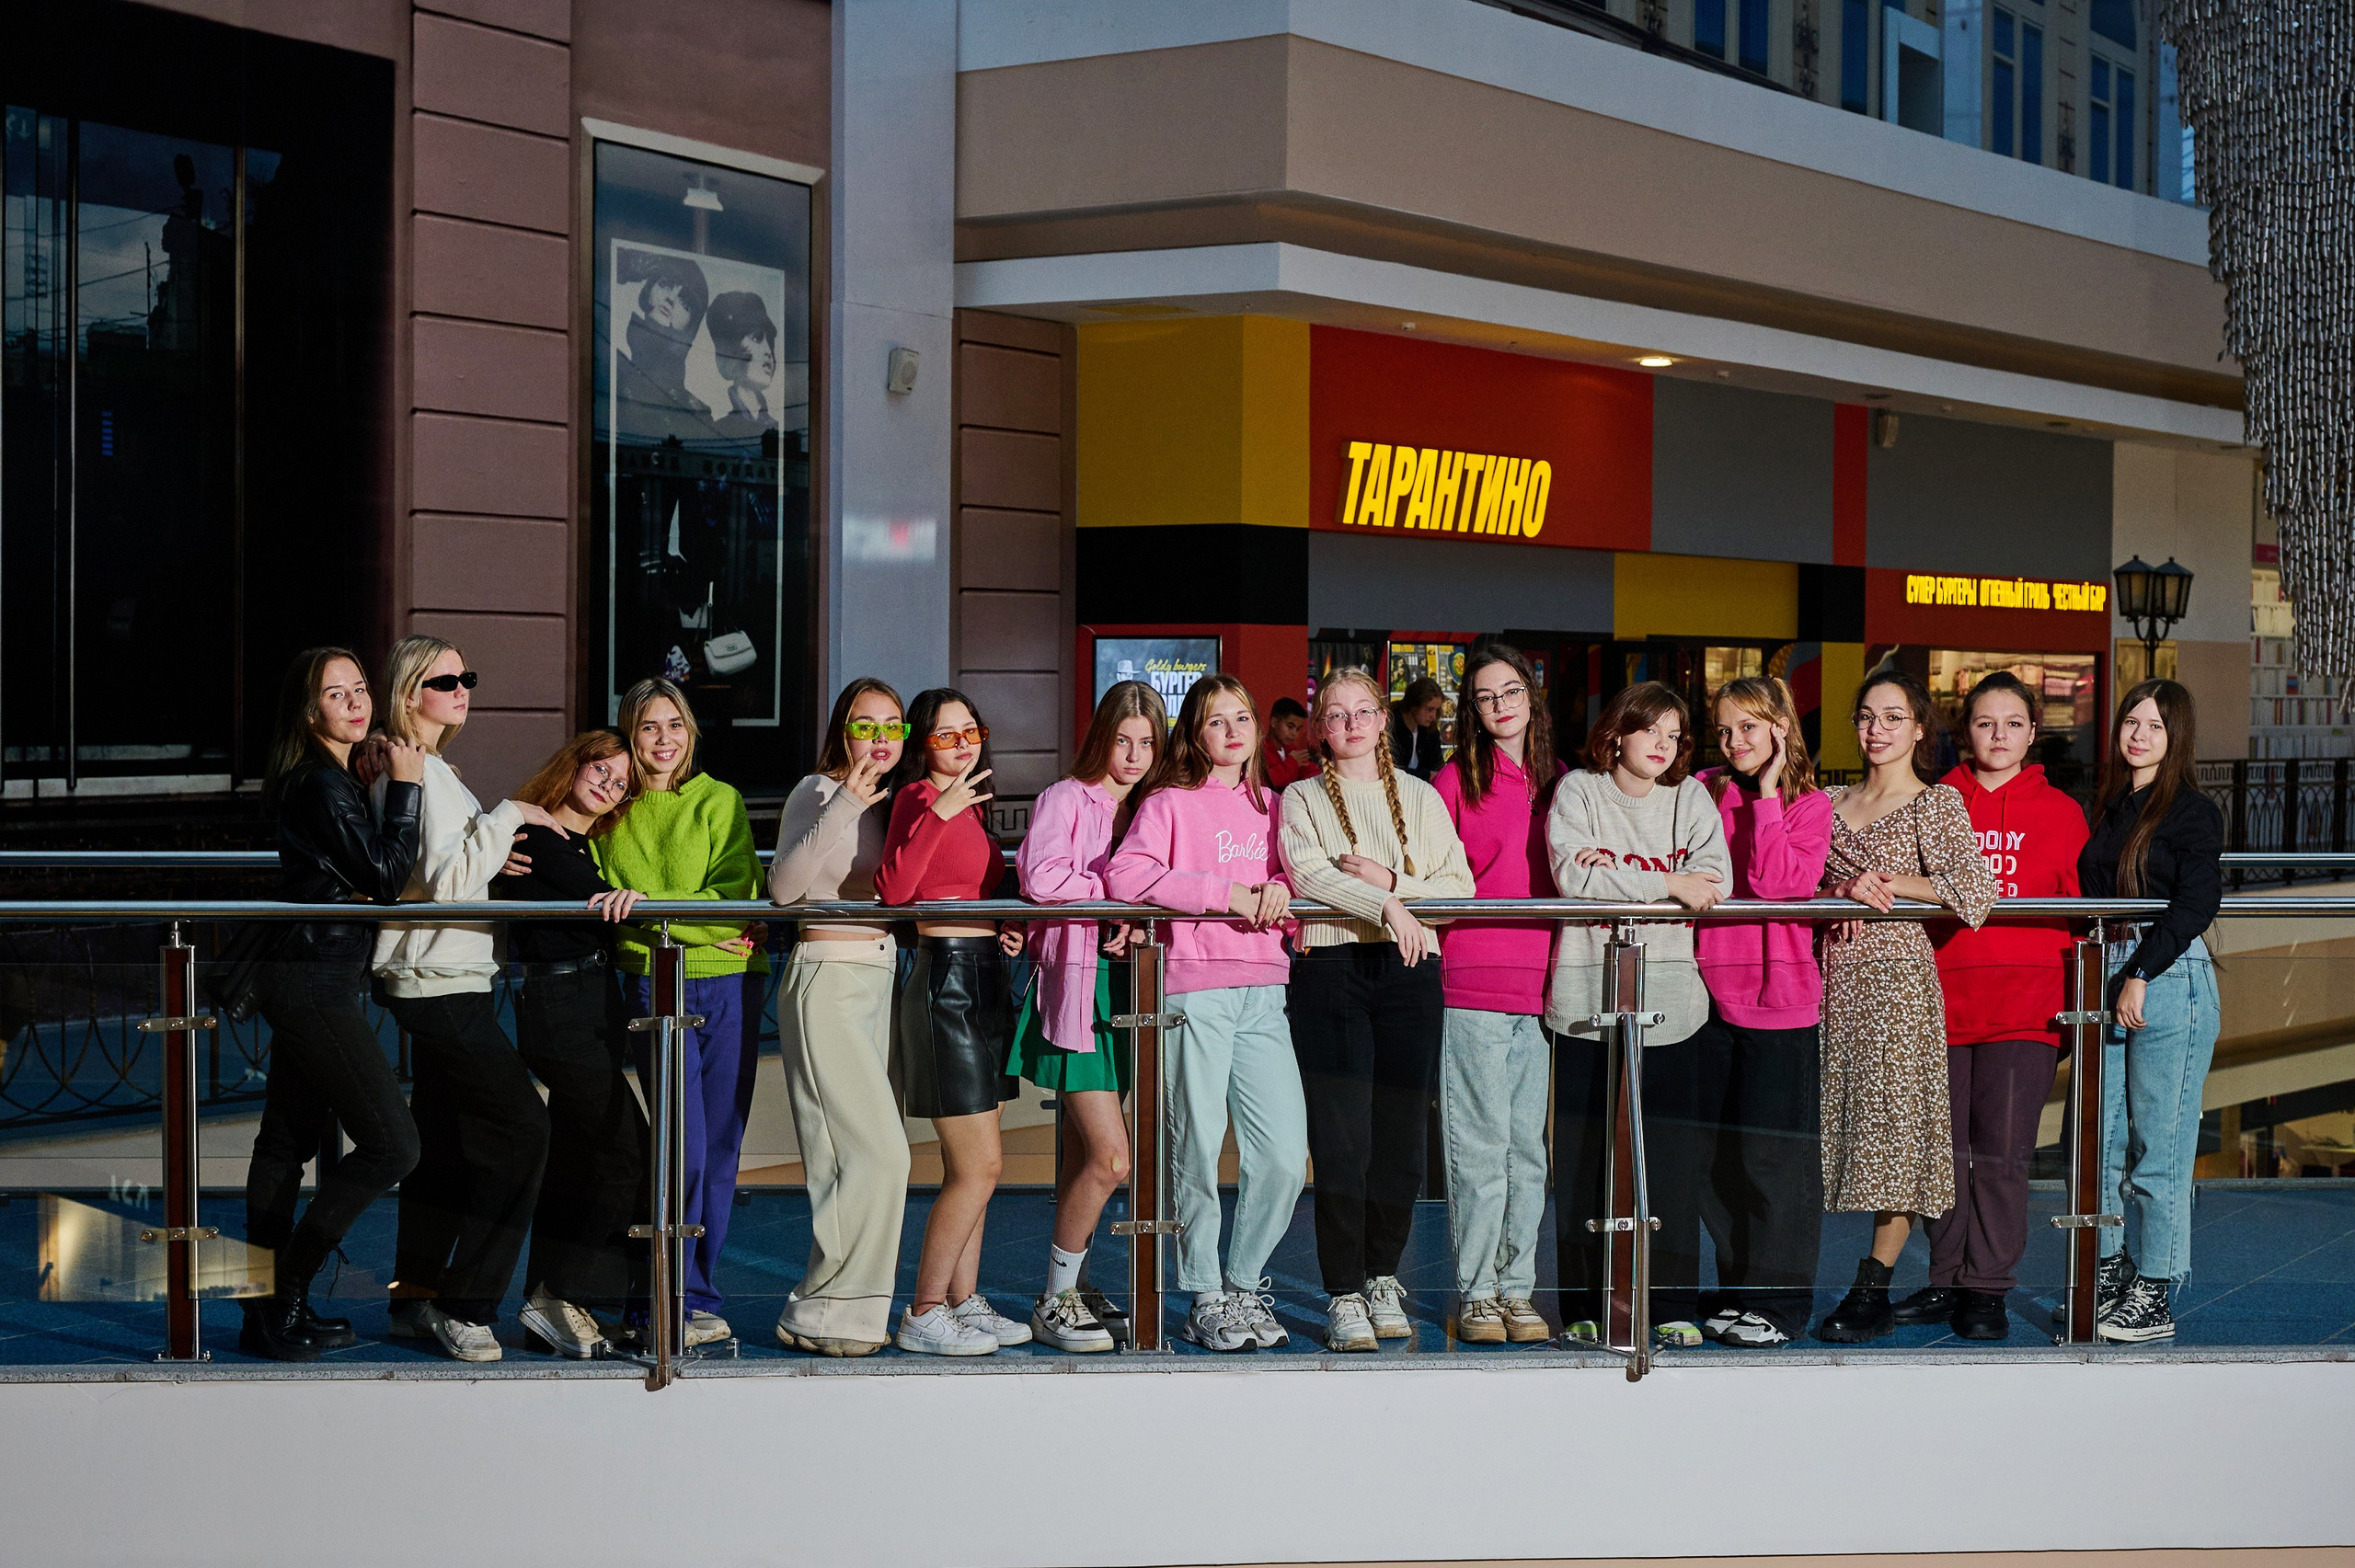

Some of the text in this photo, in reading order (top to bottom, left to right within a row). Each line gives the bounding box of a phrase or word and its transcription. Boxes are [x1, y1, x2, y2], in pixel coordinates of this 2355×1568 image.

[1342, 441, 1552, 538] ТАРАНТИНО
[1907, 575, 2106, 612] СУПЕР БУРГЕРЫ ОГНЕННЫЙ ГРИЛЬ ЧЕСТНЫЙ БАР
[1172, 658, 1207, 673] burgers
[1215, 830, 1269, 864] Barbie
